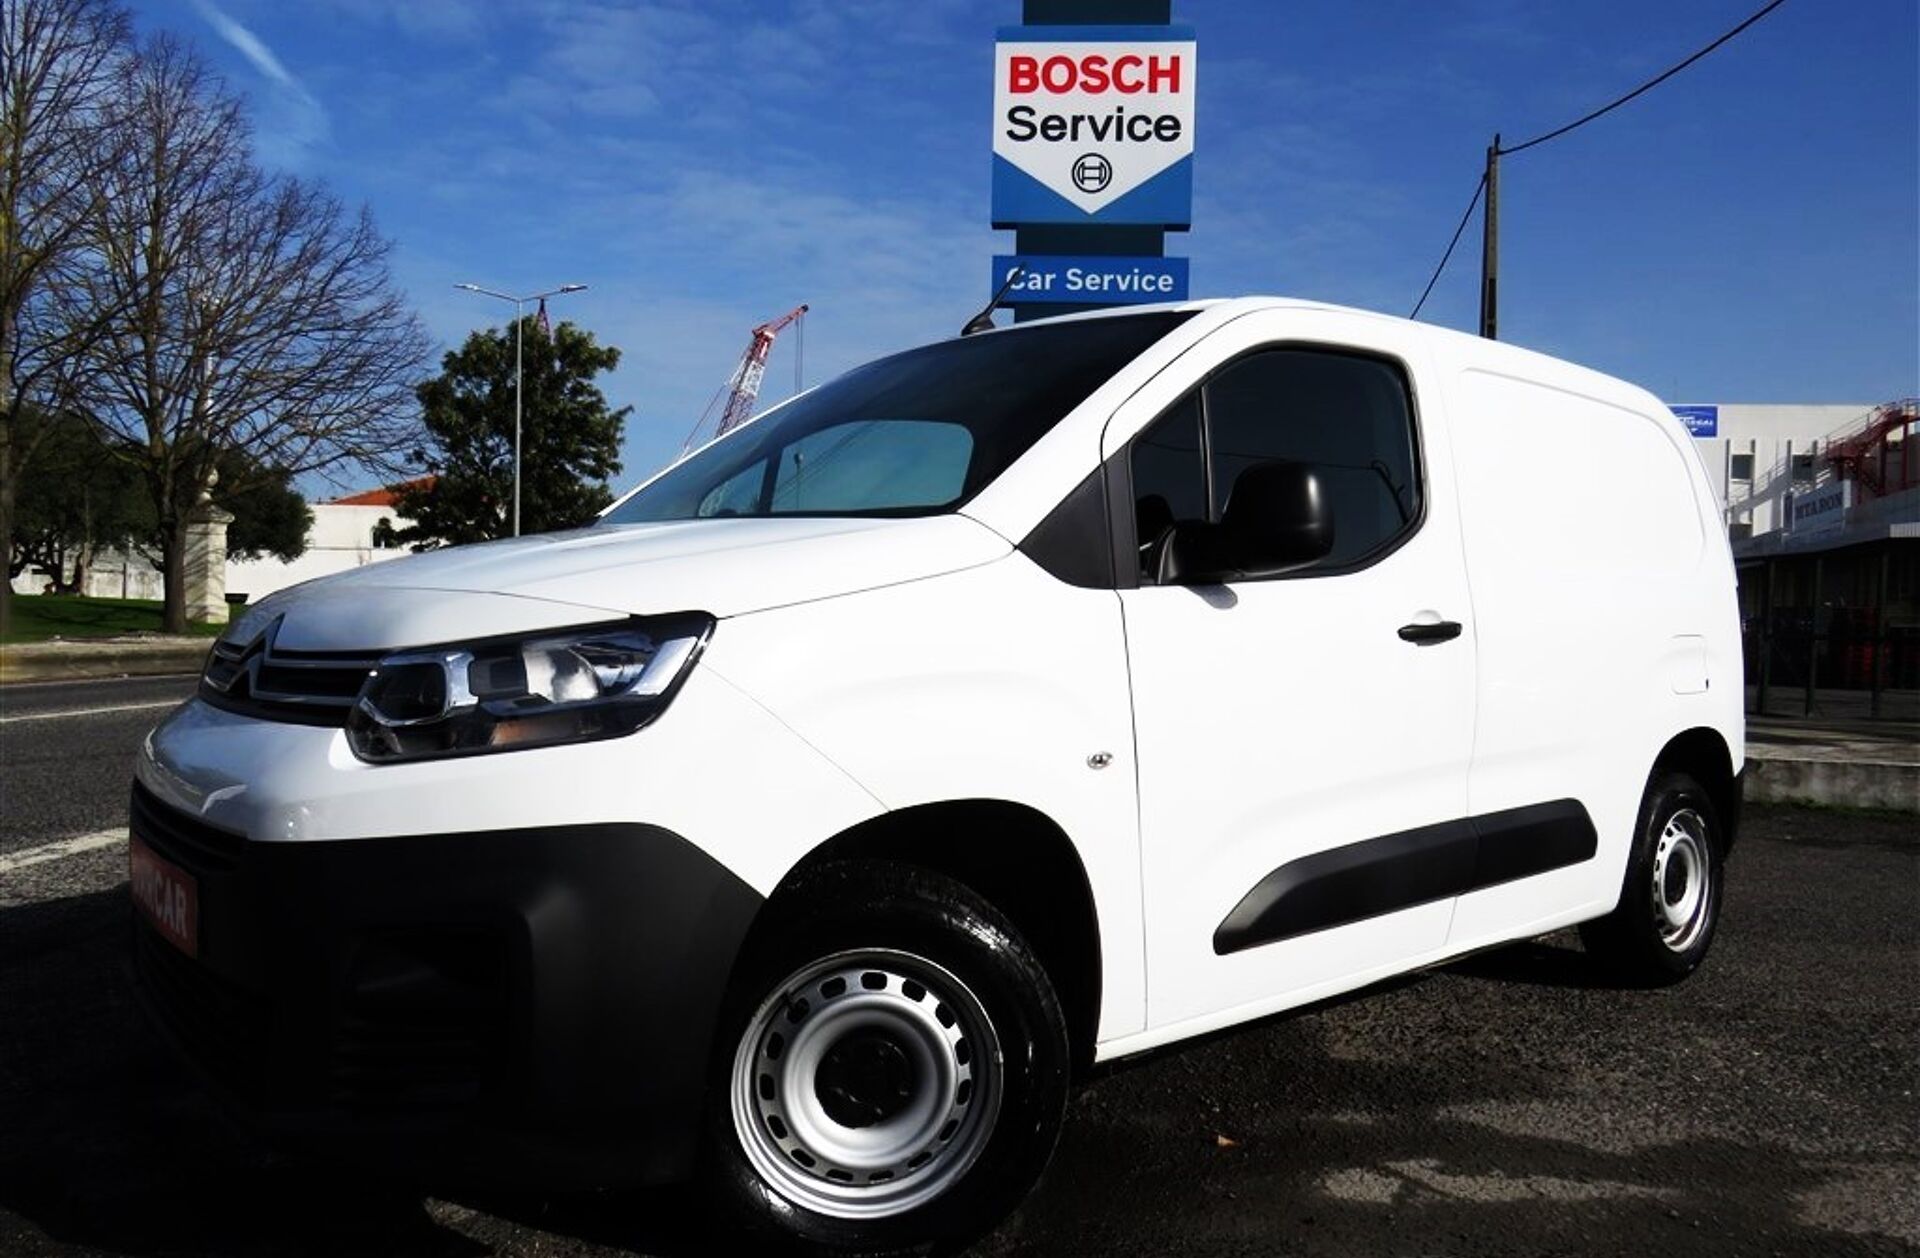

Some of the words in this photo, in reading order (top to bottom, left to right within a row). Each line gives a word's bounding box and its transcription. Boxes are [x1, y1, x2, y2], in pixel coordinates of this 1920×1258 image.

[1009, 55, 1181, 94] BOSCH
[1006, 105, 1181, 142] Service
[1006, 266, 1056, 291] Car
[1065, 268, 1174, 292] Service
